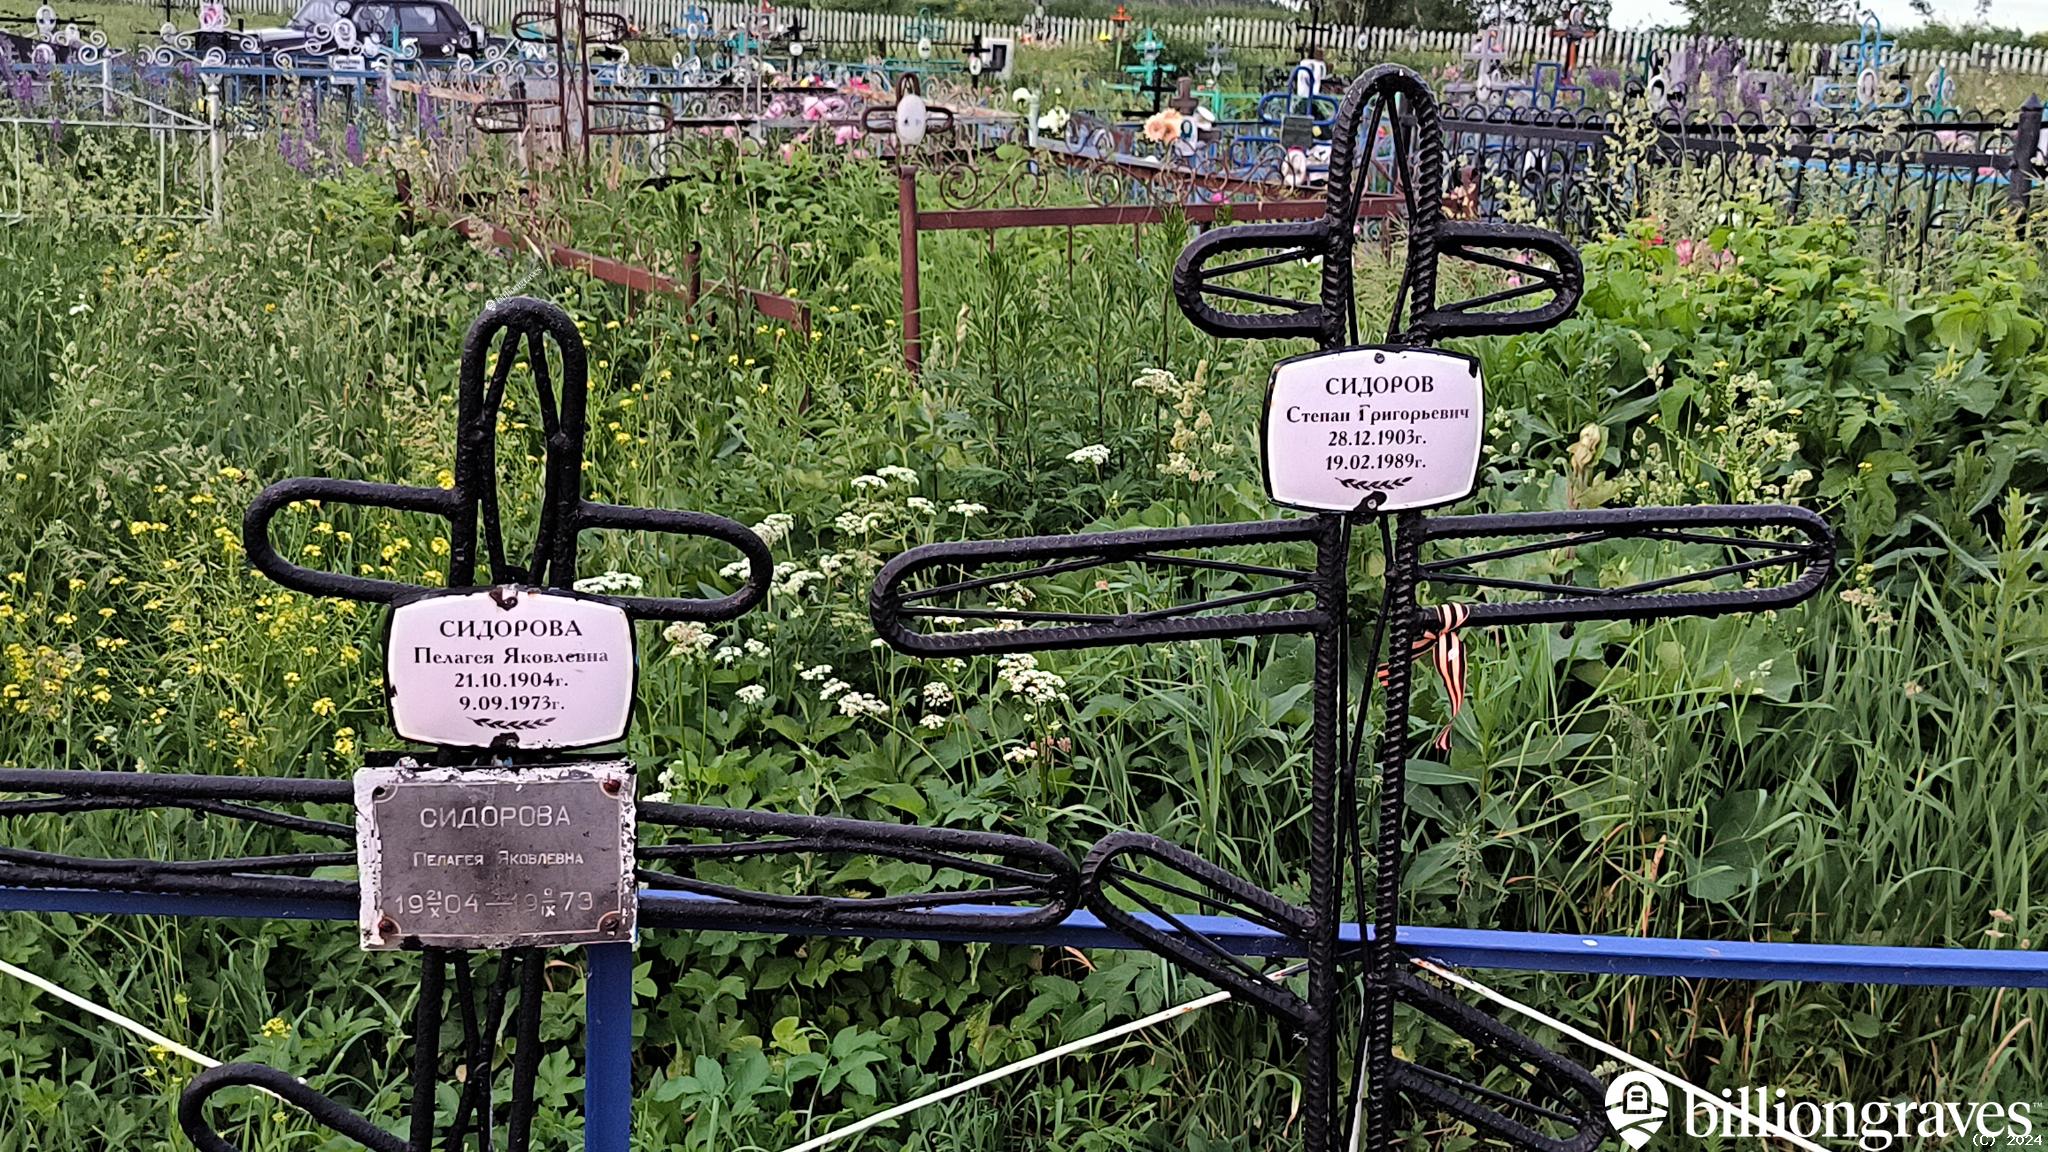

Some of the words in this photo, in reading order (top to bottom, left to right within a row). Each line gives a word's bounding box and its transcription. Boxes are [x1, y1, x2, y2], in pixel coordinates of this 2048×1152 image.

[1325, 375, 1434, 398] СИДОРОВ
[1286, 405, 1350, 423] Степан
[1358, 404, 1470, 425] Григорьевич
[1328, 428, 1427, 447] 28.12.1903г.
[1325, 452, 1426, 470] 19.02.1989г.
[439, 619, 583, 641] СИДОРОВА
[413, 646, 494, 665] Пелагея
[503, 647, 609, 664] Яковлевна
[454, 672, 569, 688] 21.10.1904г.
[459, 695, 565, 711] 9.09.1973г.
[420, 804, 571, 829] СИДОРОВА
